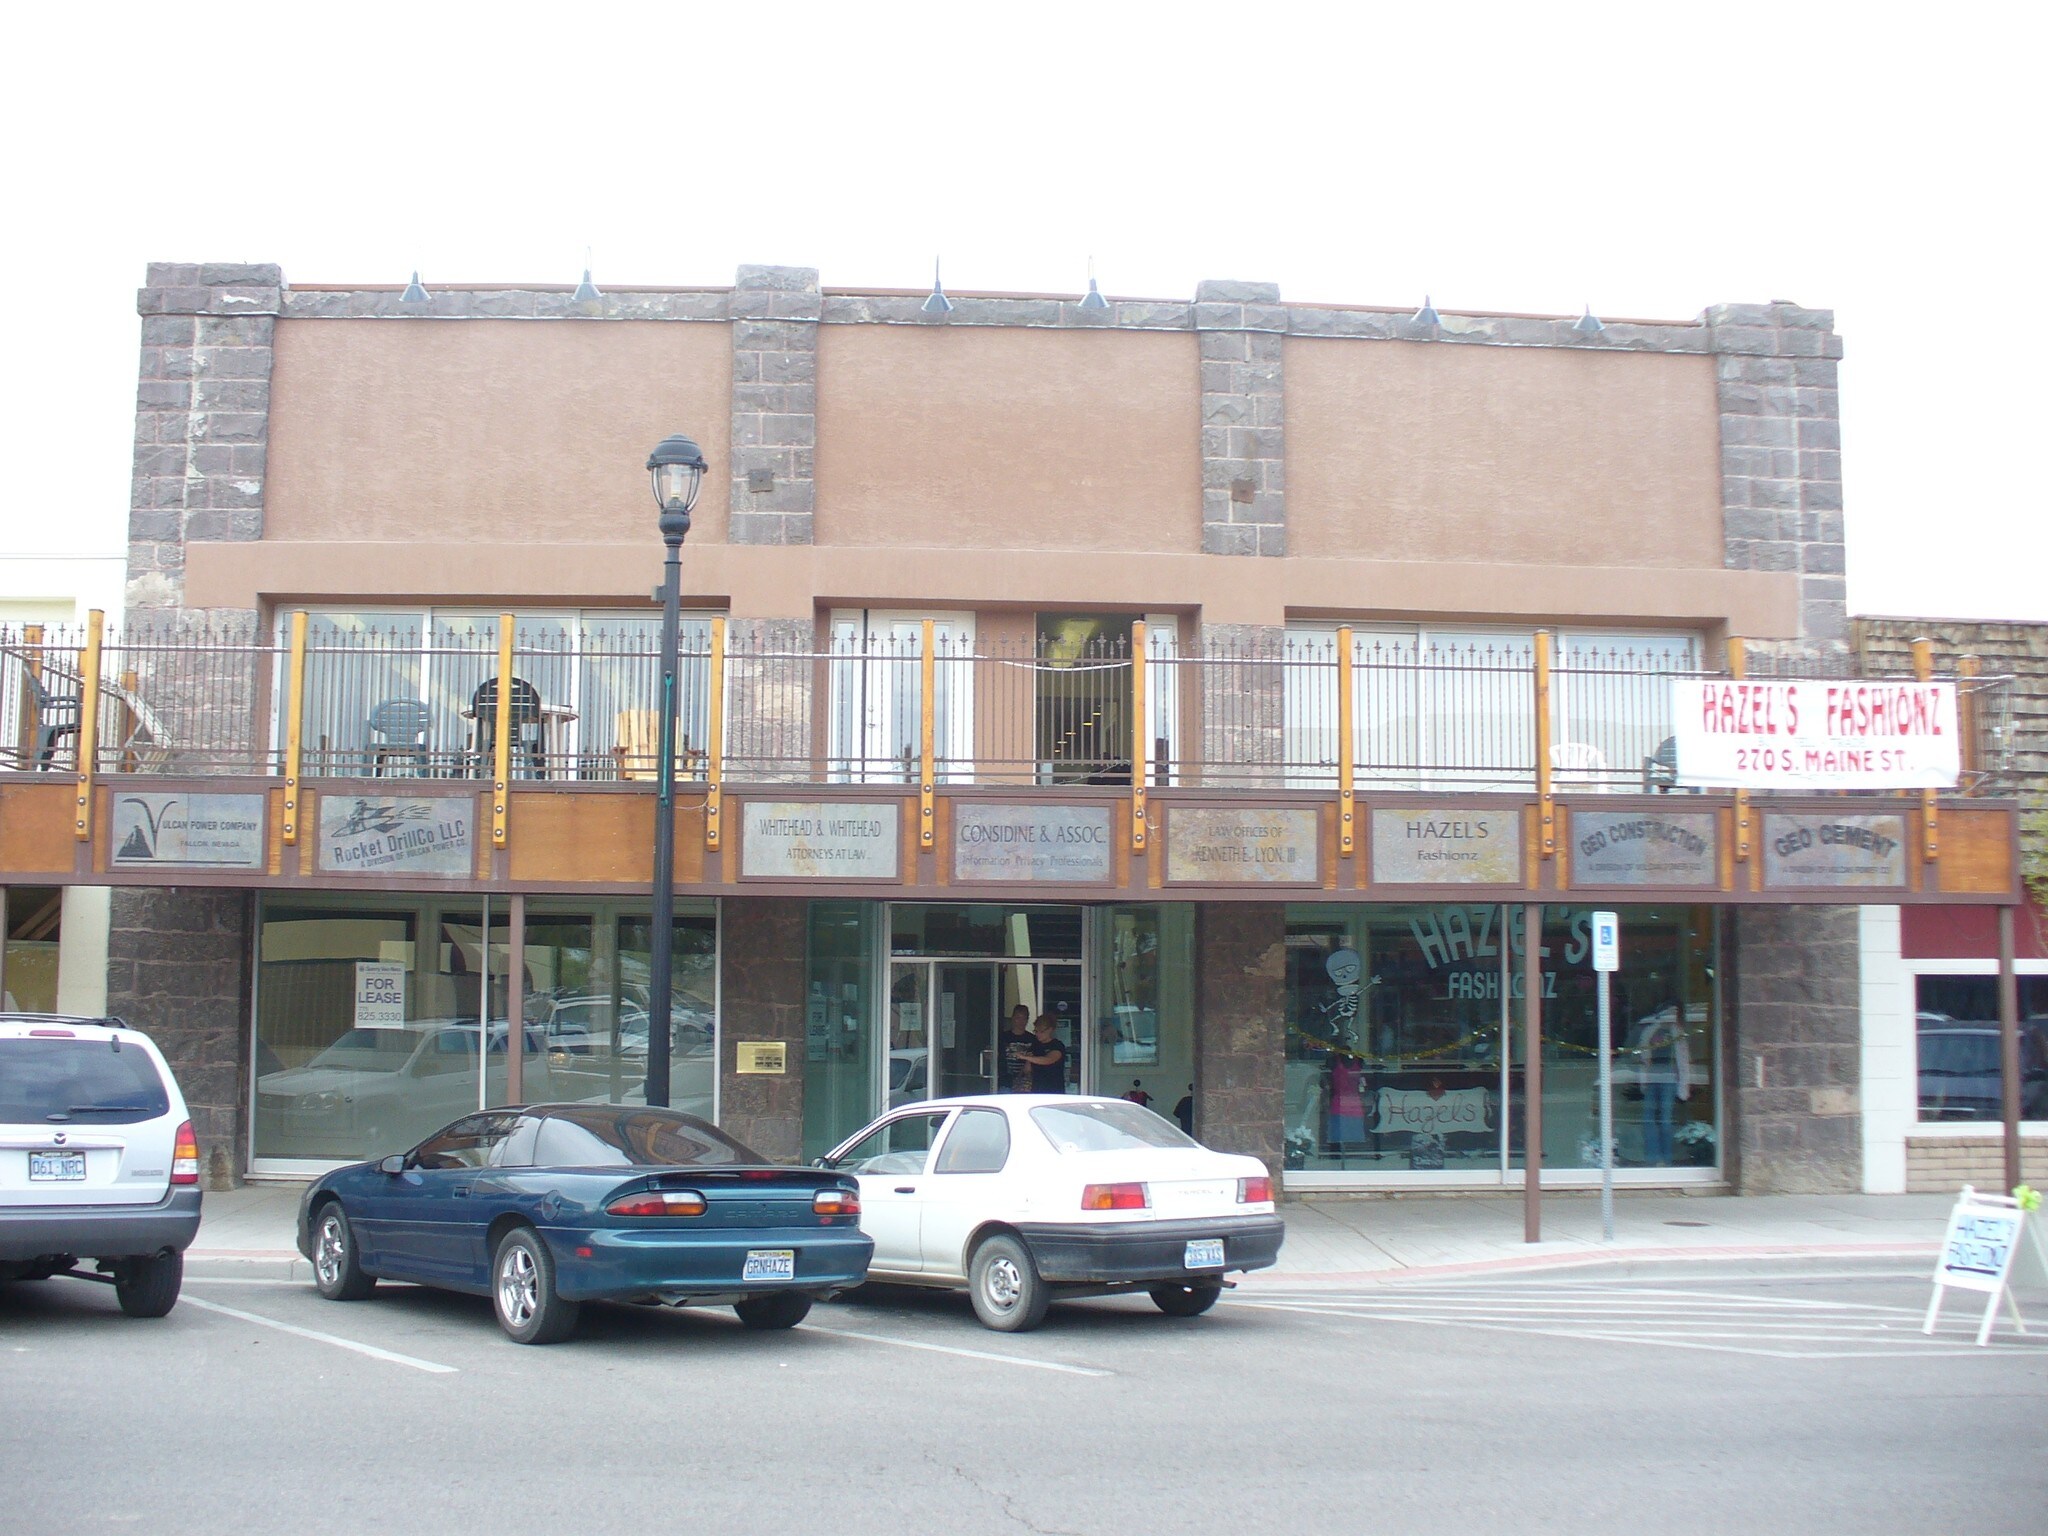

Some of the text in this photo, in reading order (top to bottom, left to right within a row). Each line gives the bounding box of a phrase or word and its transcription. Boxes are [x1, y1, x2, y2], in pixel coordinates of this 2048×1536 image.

[1703, 684, 1943, 736] HAZEL'S FASHIONZ
[1736, 748, 1916, 772] 270 S. MAINE ST.
[190, 820, 219, 831] POWER
[221, 821, 258, 831] COMPANY
[759, 819, 882, 838] WHITEHEAD & WHITEHEAD
[960, 825, 1107, 844] CONSIDINE & ASSOC.
[1233, 826, 1269, 838] OFFICES
[1269, 826, 1283, 838] OF
[1406, 821, 1489, 839] HAZEL'S
[334, 820, 466, 864] Rocket DrillCo LLC
[1580, 831, 1607, 857] GEO
[1775, 828, 1812, 857] GEO
[786, 848, 866, 860] ATTORNEYS AT LAW
[962, 854, 1011, 866] Information
[1417, 850, 1479, 861] Fashionz
[365, 978, 394, 990] FOR
[358, 991, 402, 1004] LEASE
[1386, 1093, 1476, 1133] Hazels
[747, 1259, 791, 1274] GRNHAZE
